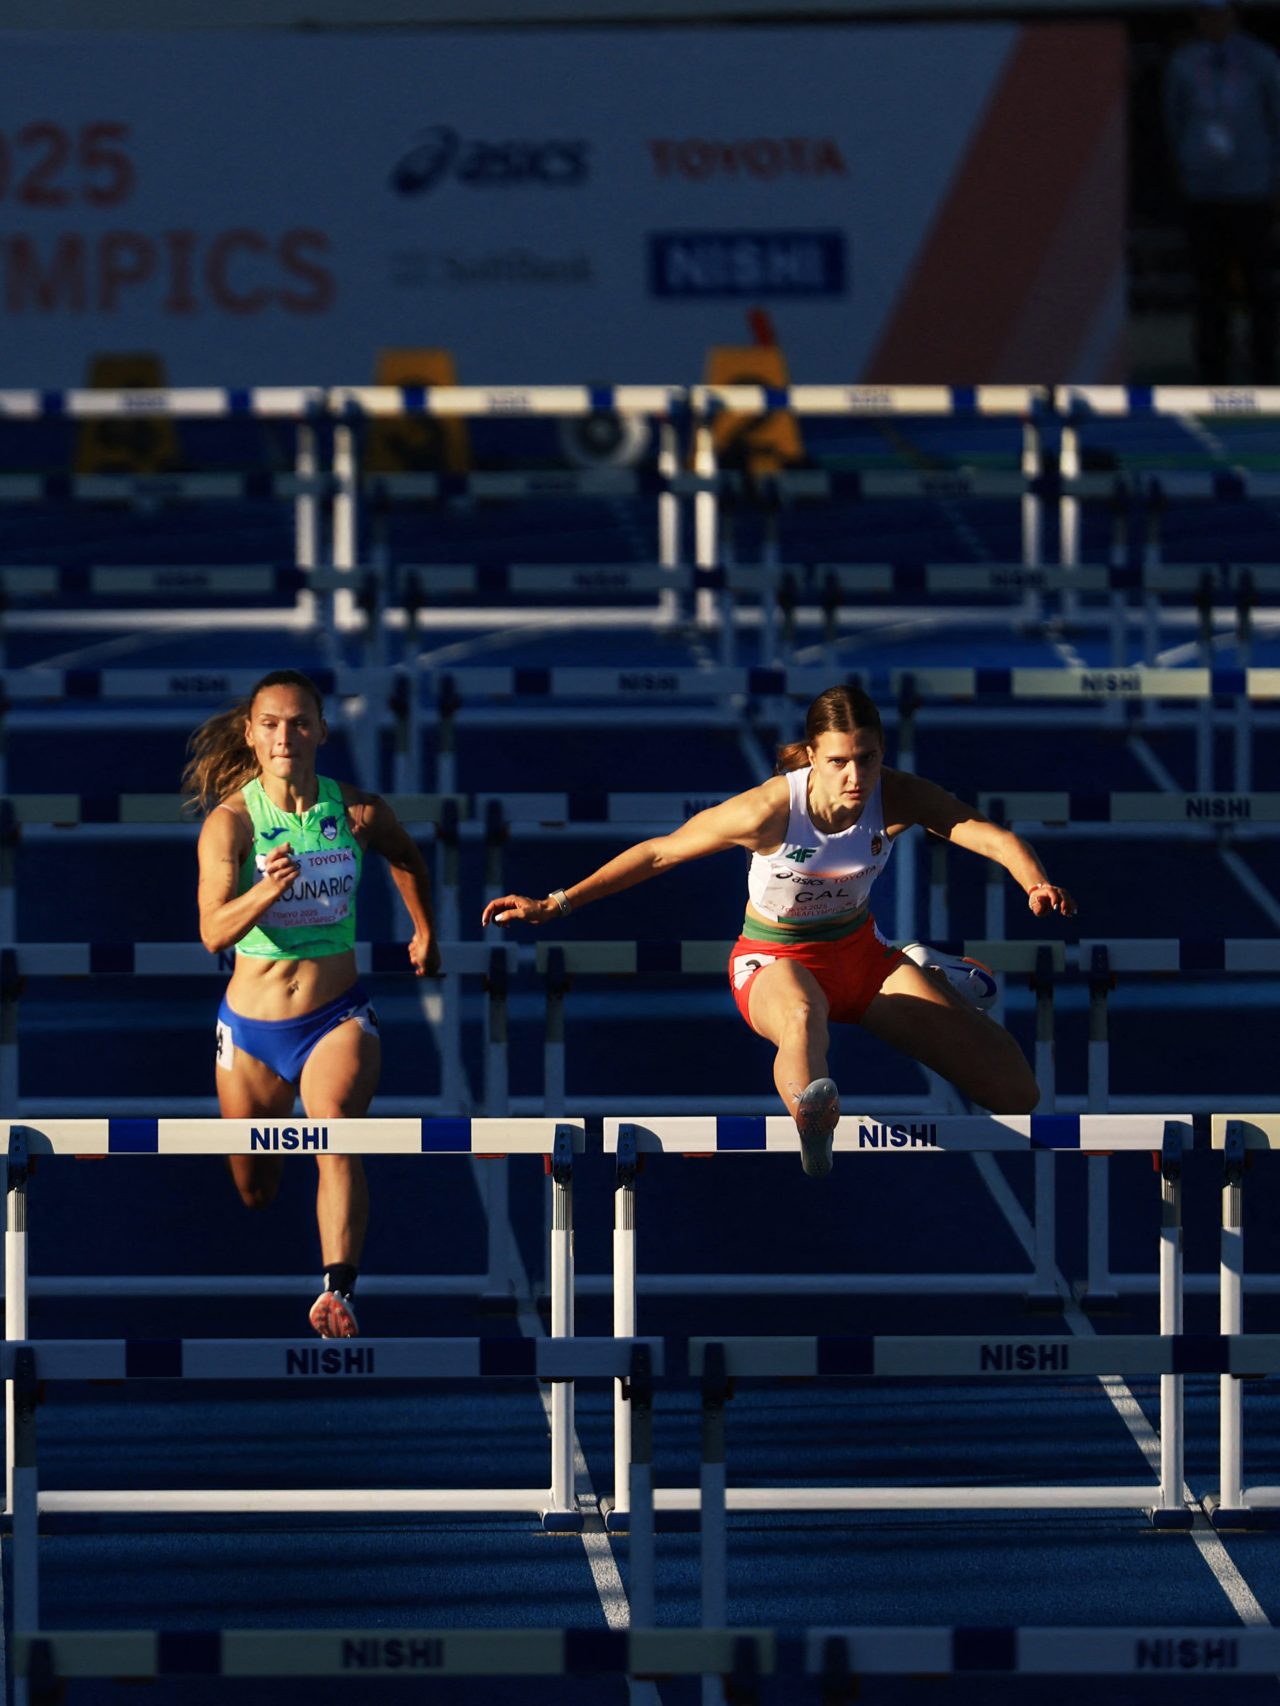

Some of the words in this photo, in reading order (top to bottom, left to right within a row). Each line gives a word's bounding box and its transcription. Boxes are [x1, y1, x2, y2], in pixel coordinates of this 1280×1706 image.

[647, 137, 848, 182] TOYOTA
[666, 238, 827, 287] NISHI
[1081, 673, 1142, 693] NISHI
[1186, 798, 1251, 819] NISHI
[310, 852, 361, 867] TOYOTA
[276, 874, 354, 902] OJNARIC
[832, 865, 877, 885] TOYOTA
[795, 889, 848, 902] GAL
[250, 1127, 329, 1151] NISHI
[859, 1124, 938, 1149] NISHI
[286, 1347, 375, 1374] NISHI
[980, 1344, 1069, 1371] NISHI
[341, 1638, 443, 1669] NISHI
[1135, 1638, 1238, 1669] NISHI
